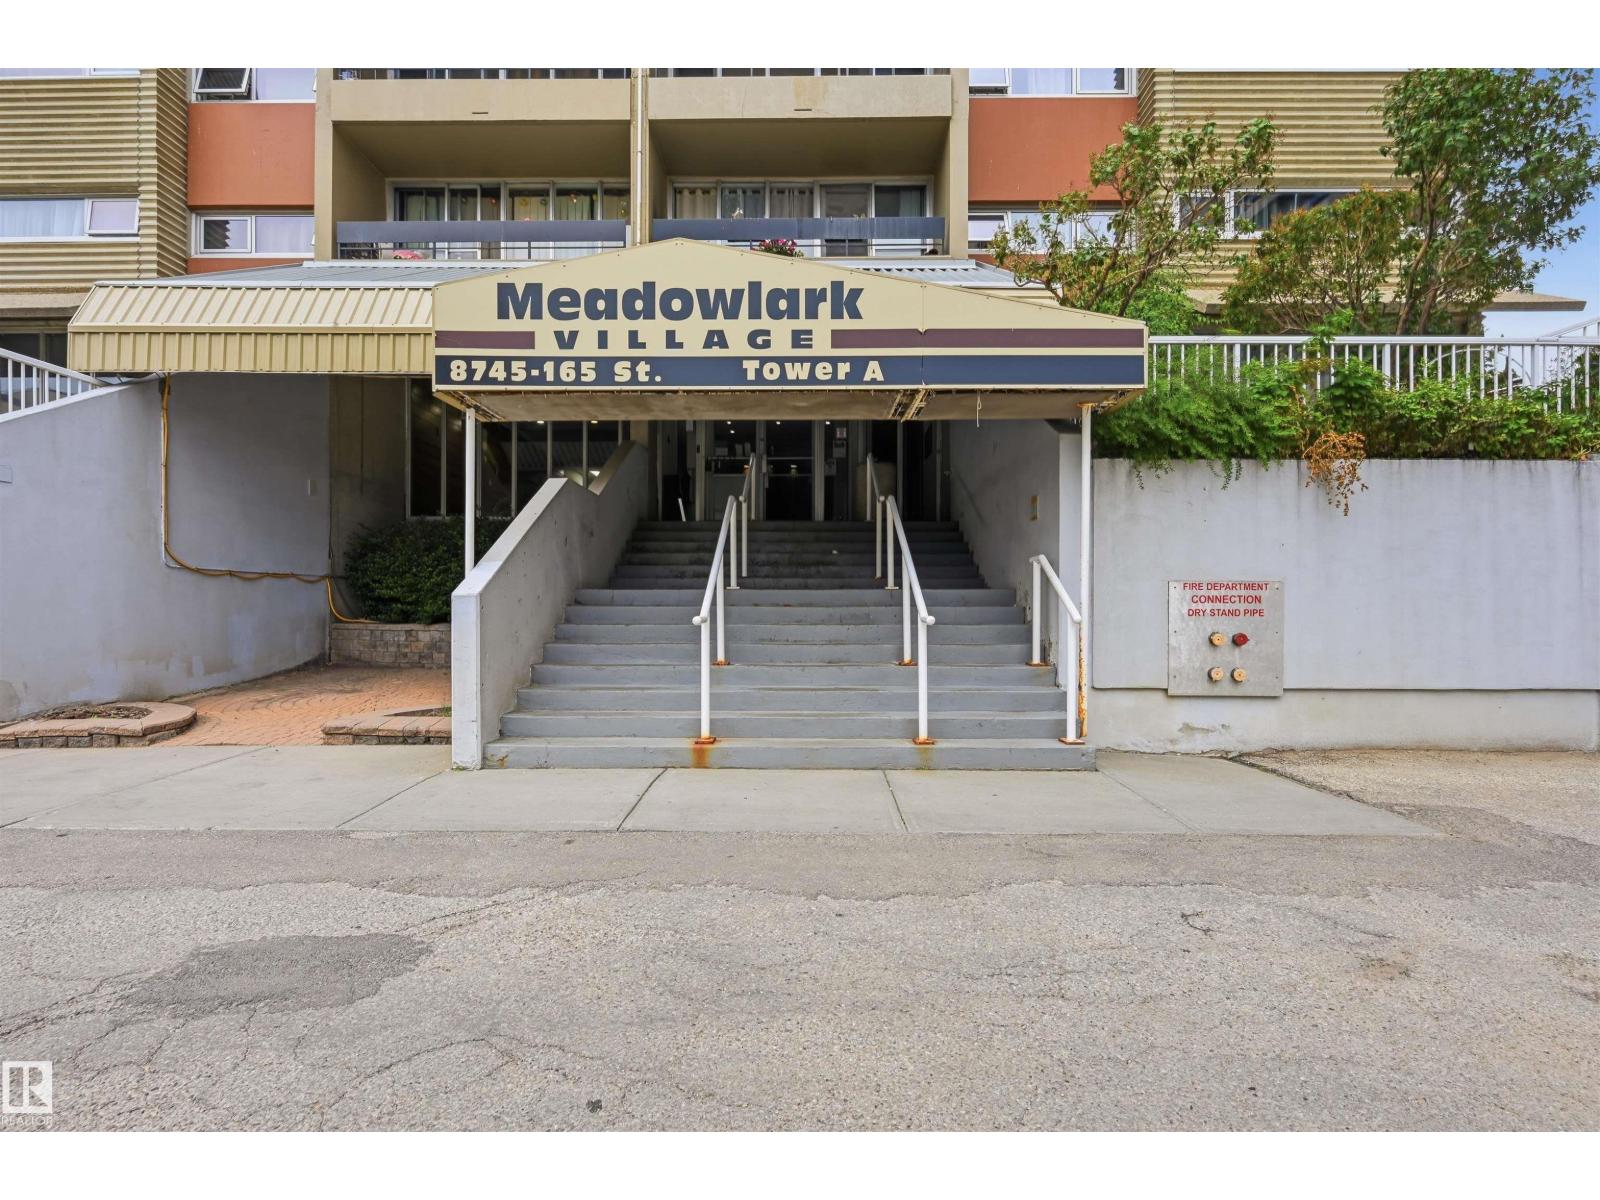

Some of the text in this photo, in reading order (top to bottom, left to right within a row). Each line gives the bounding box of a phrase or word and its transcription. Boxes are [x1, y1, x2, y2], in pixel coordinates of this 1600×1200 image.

[496, 280, 865, 321] Meadowlark
[553, 328, 815, 350] VILLAGE
[449, 359, 663, 383] 8745-165 St.
[742, 359, 885, 382] Tower A
[1183, 582, 1269, 591] FIRE DEPARTMENT
[1191, 594, 1262, 604] CONNECTION
[1187, 608, 1265, 617] DRY STAND PIPE
